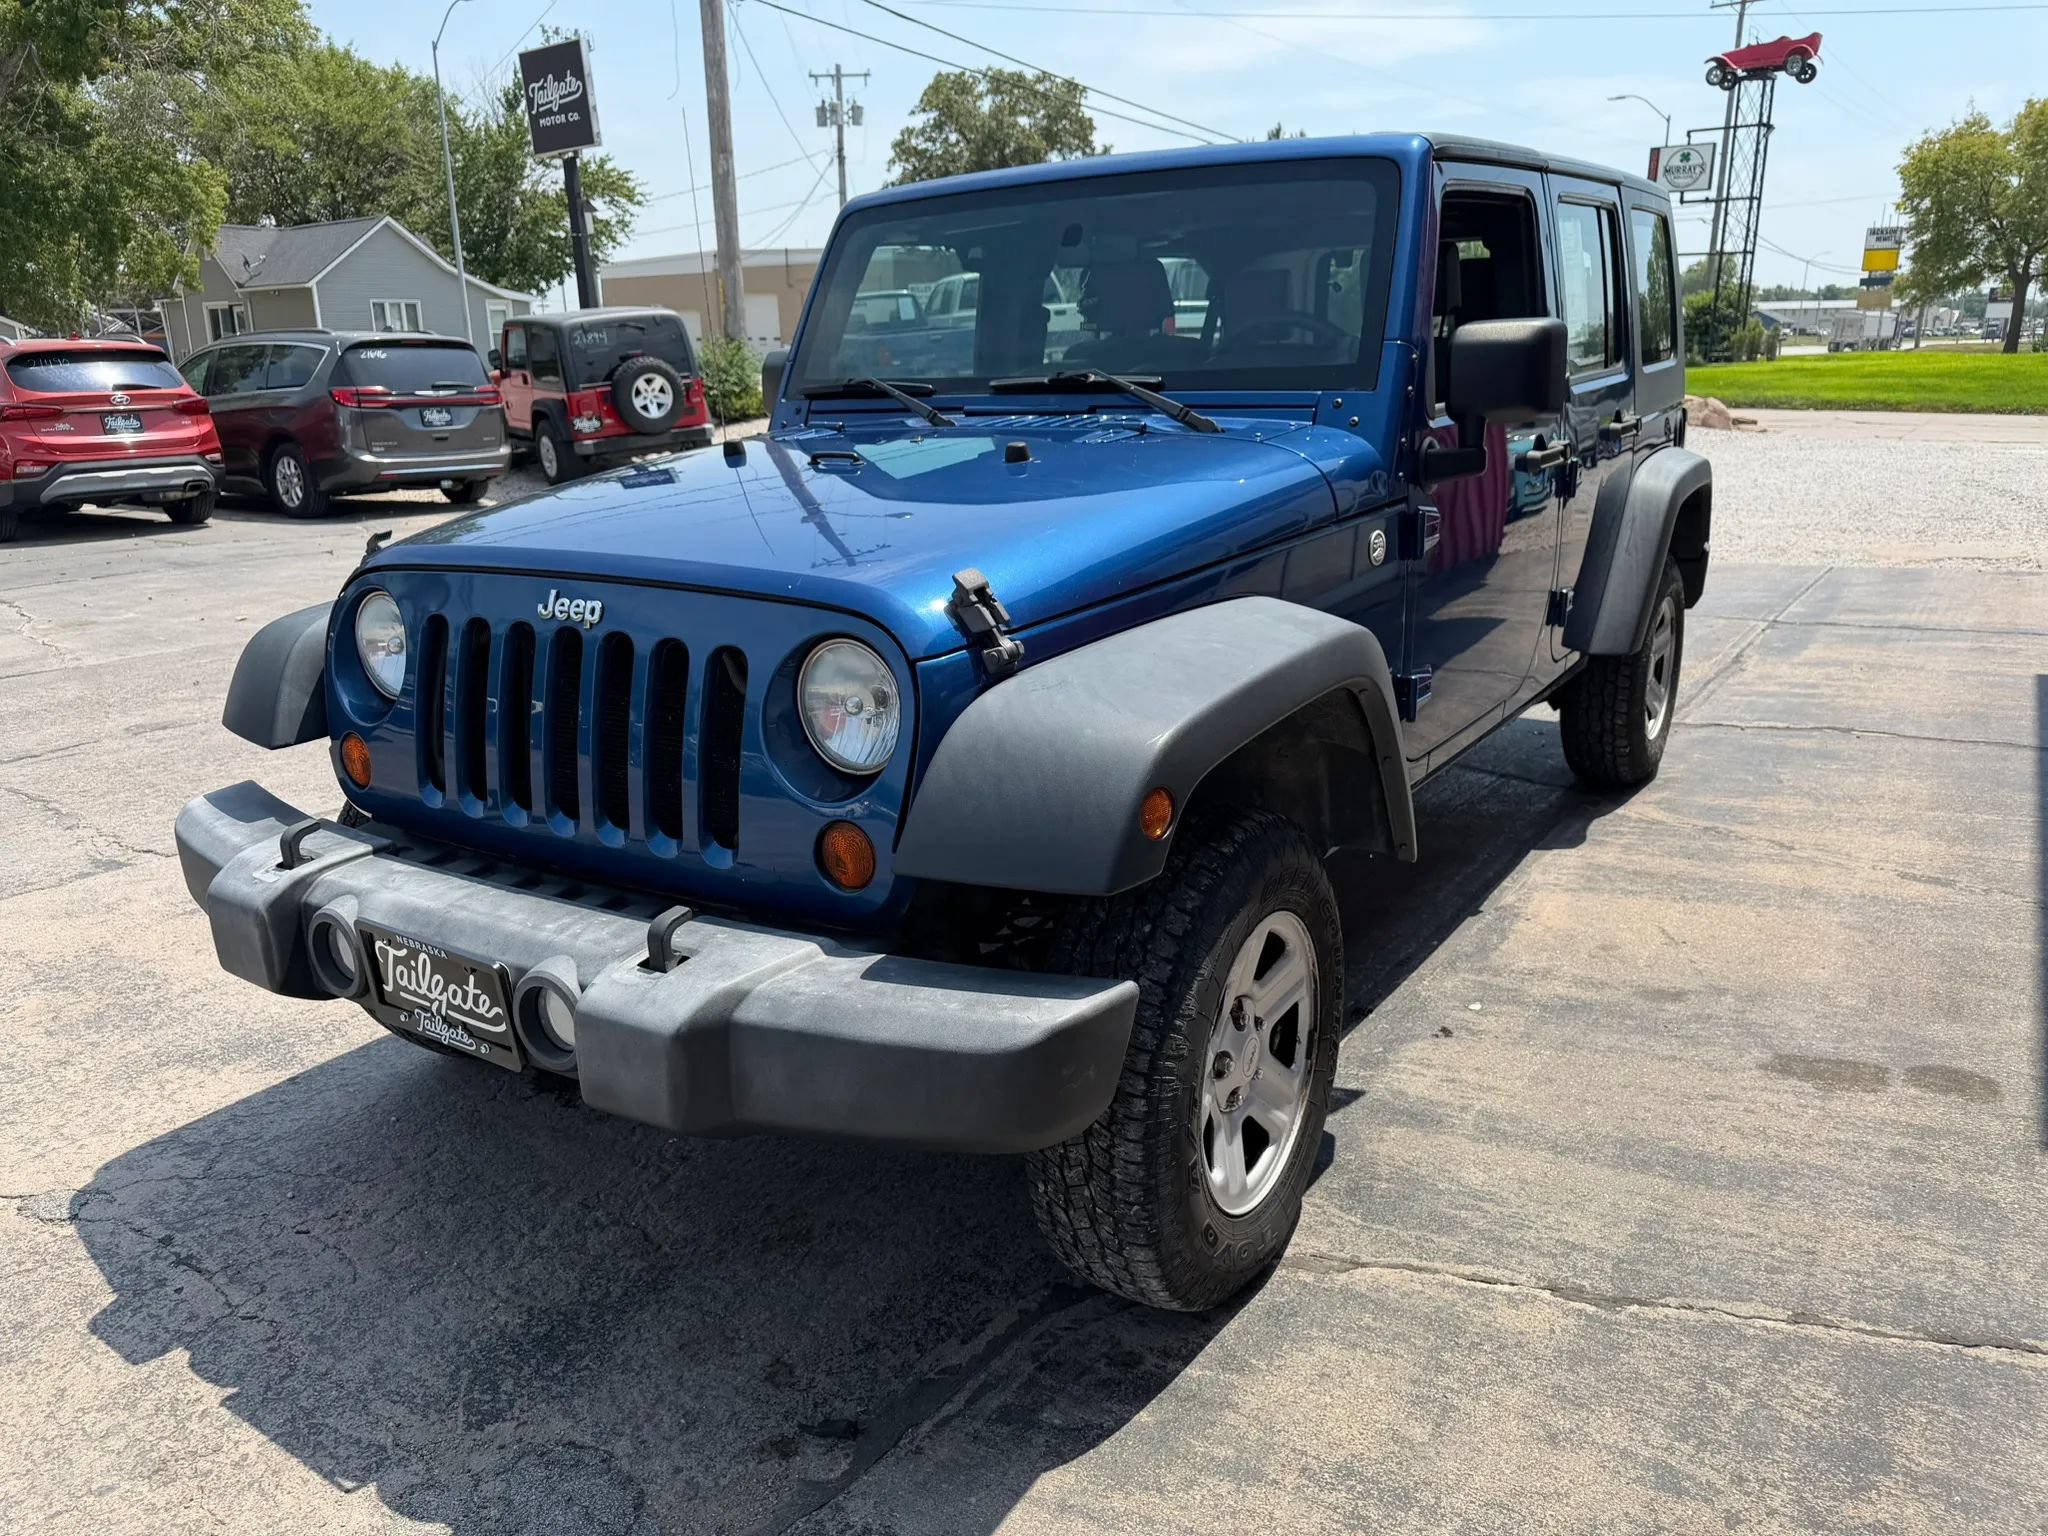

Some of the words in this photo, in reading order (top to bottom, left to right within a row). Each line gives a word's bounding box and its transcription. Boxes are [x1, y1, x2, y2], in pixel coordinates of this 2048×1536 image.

[529, 69, 583, 115] Tailgate
[539, 114, 566, 128] MOTOR
[1663, 161, 1707, 177] MURRAY'S
[537, 589, 602, 629] Jeep
[396, 935, 448, 960] NEBRASKA
[375, 940, 507, 1032] Tailgate
[414, 1008, 477, 1050] Tailgate
